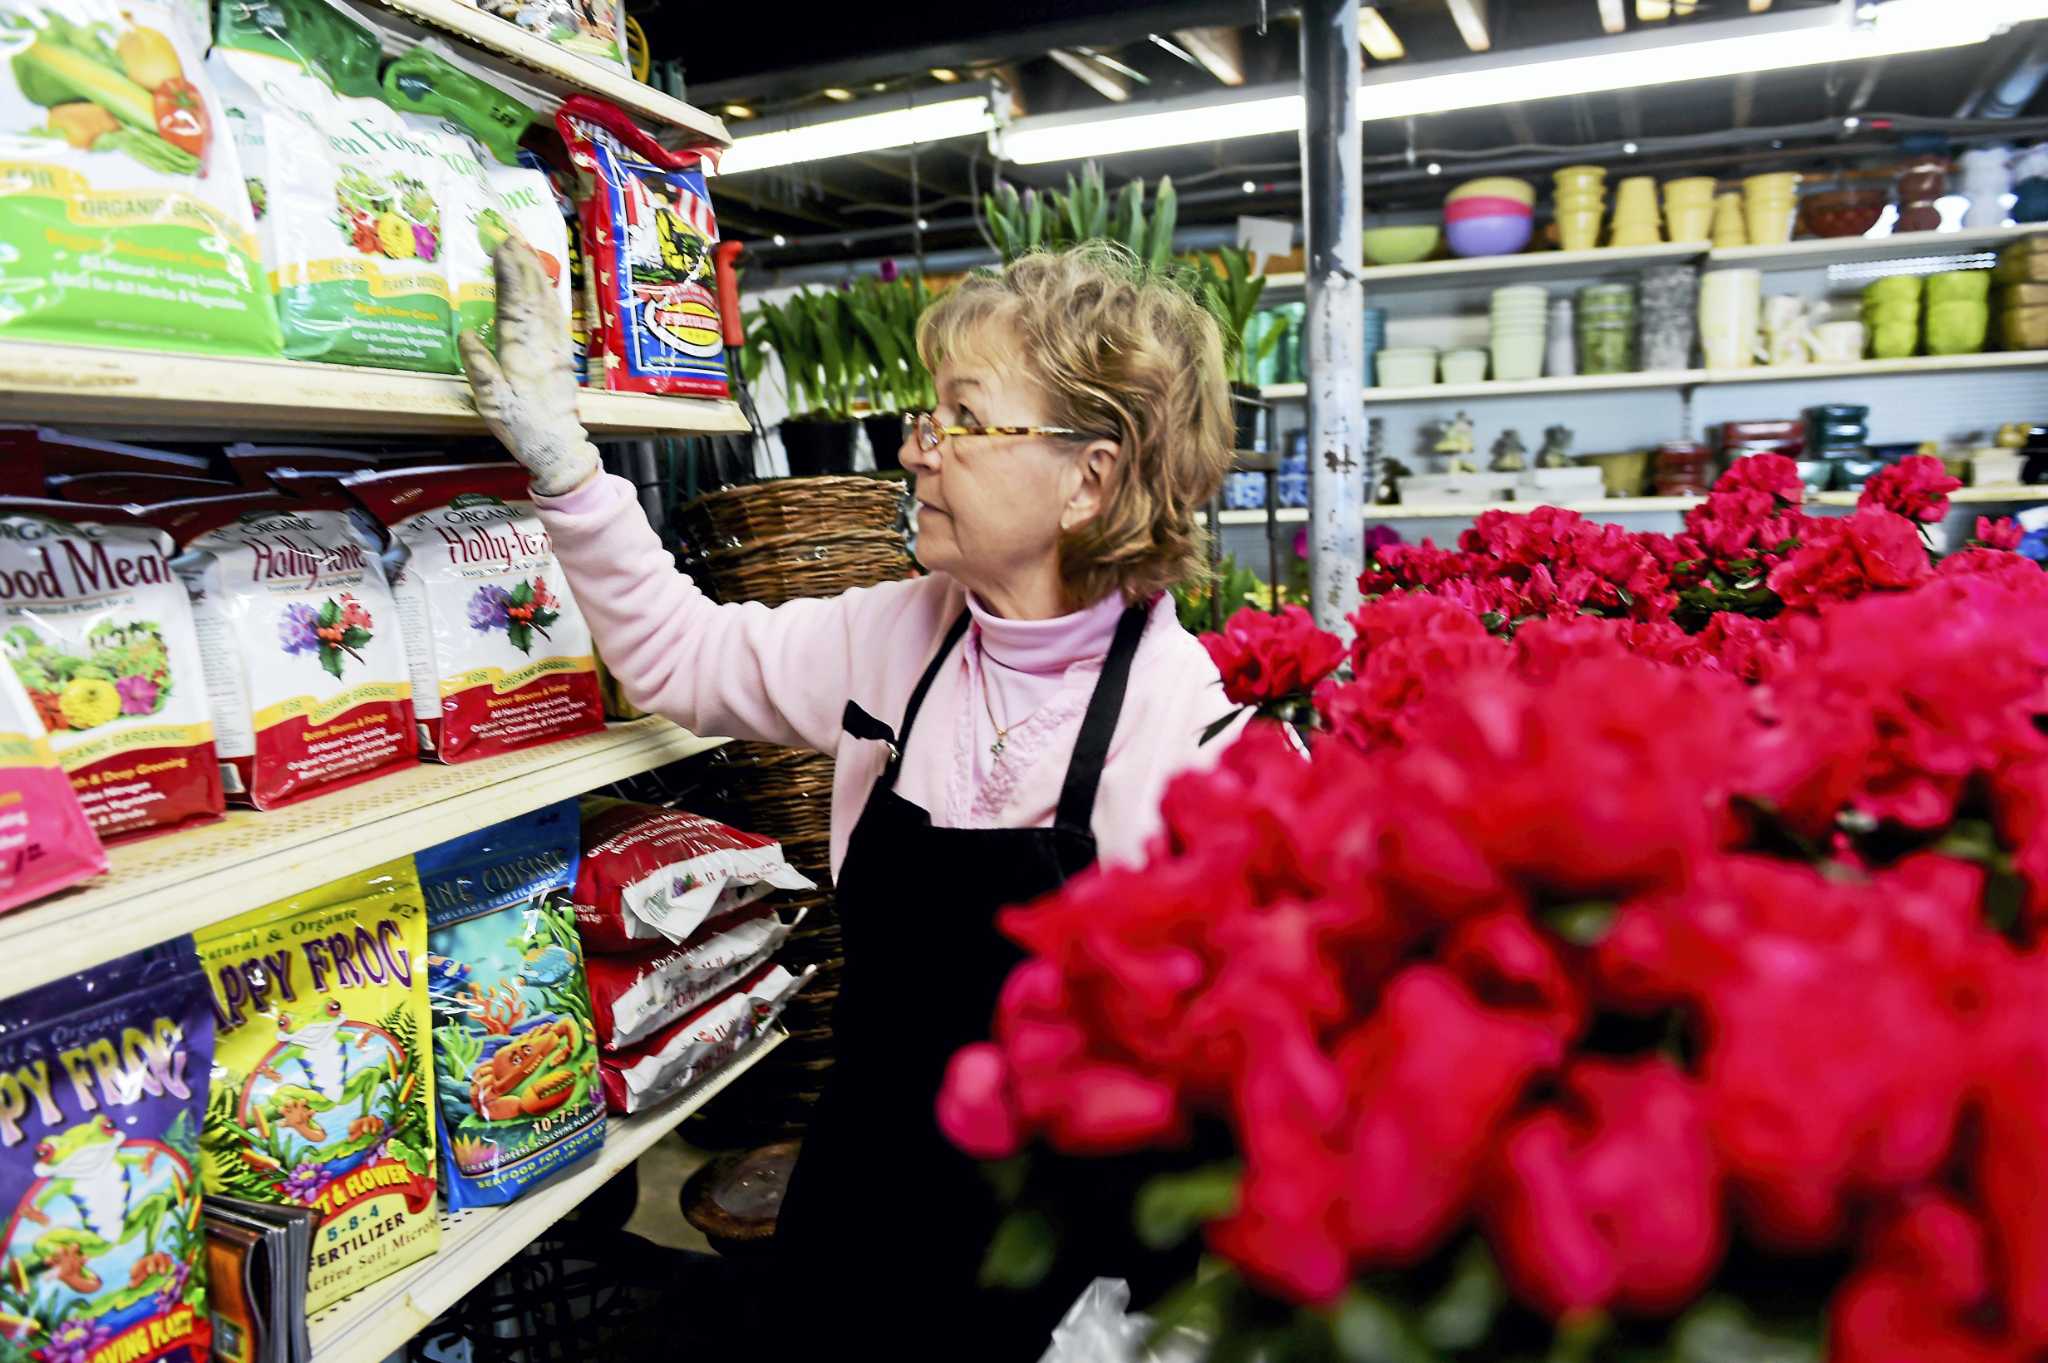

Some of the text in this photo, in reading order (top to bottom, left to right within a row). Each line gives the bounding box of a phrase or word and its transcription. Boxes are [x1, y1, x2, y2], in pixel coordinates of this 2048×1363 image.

[55, 538, 171, 595] Meal
[266, 928, 284, 943] &
[290, 908, 358, 937] Organic
[301, 919, 413, 991] FROG
[59, 1016, 192, 1111] FROG
[331, 1184, 348, 1207] &
[345, 1163, 412, 1197] FLOWER
[476, 1162, 537, 1189] SEAFOOD
[307, 1212, 406, 1273] FERTILIZER
[358, 1243, 388, 1266] Soil
